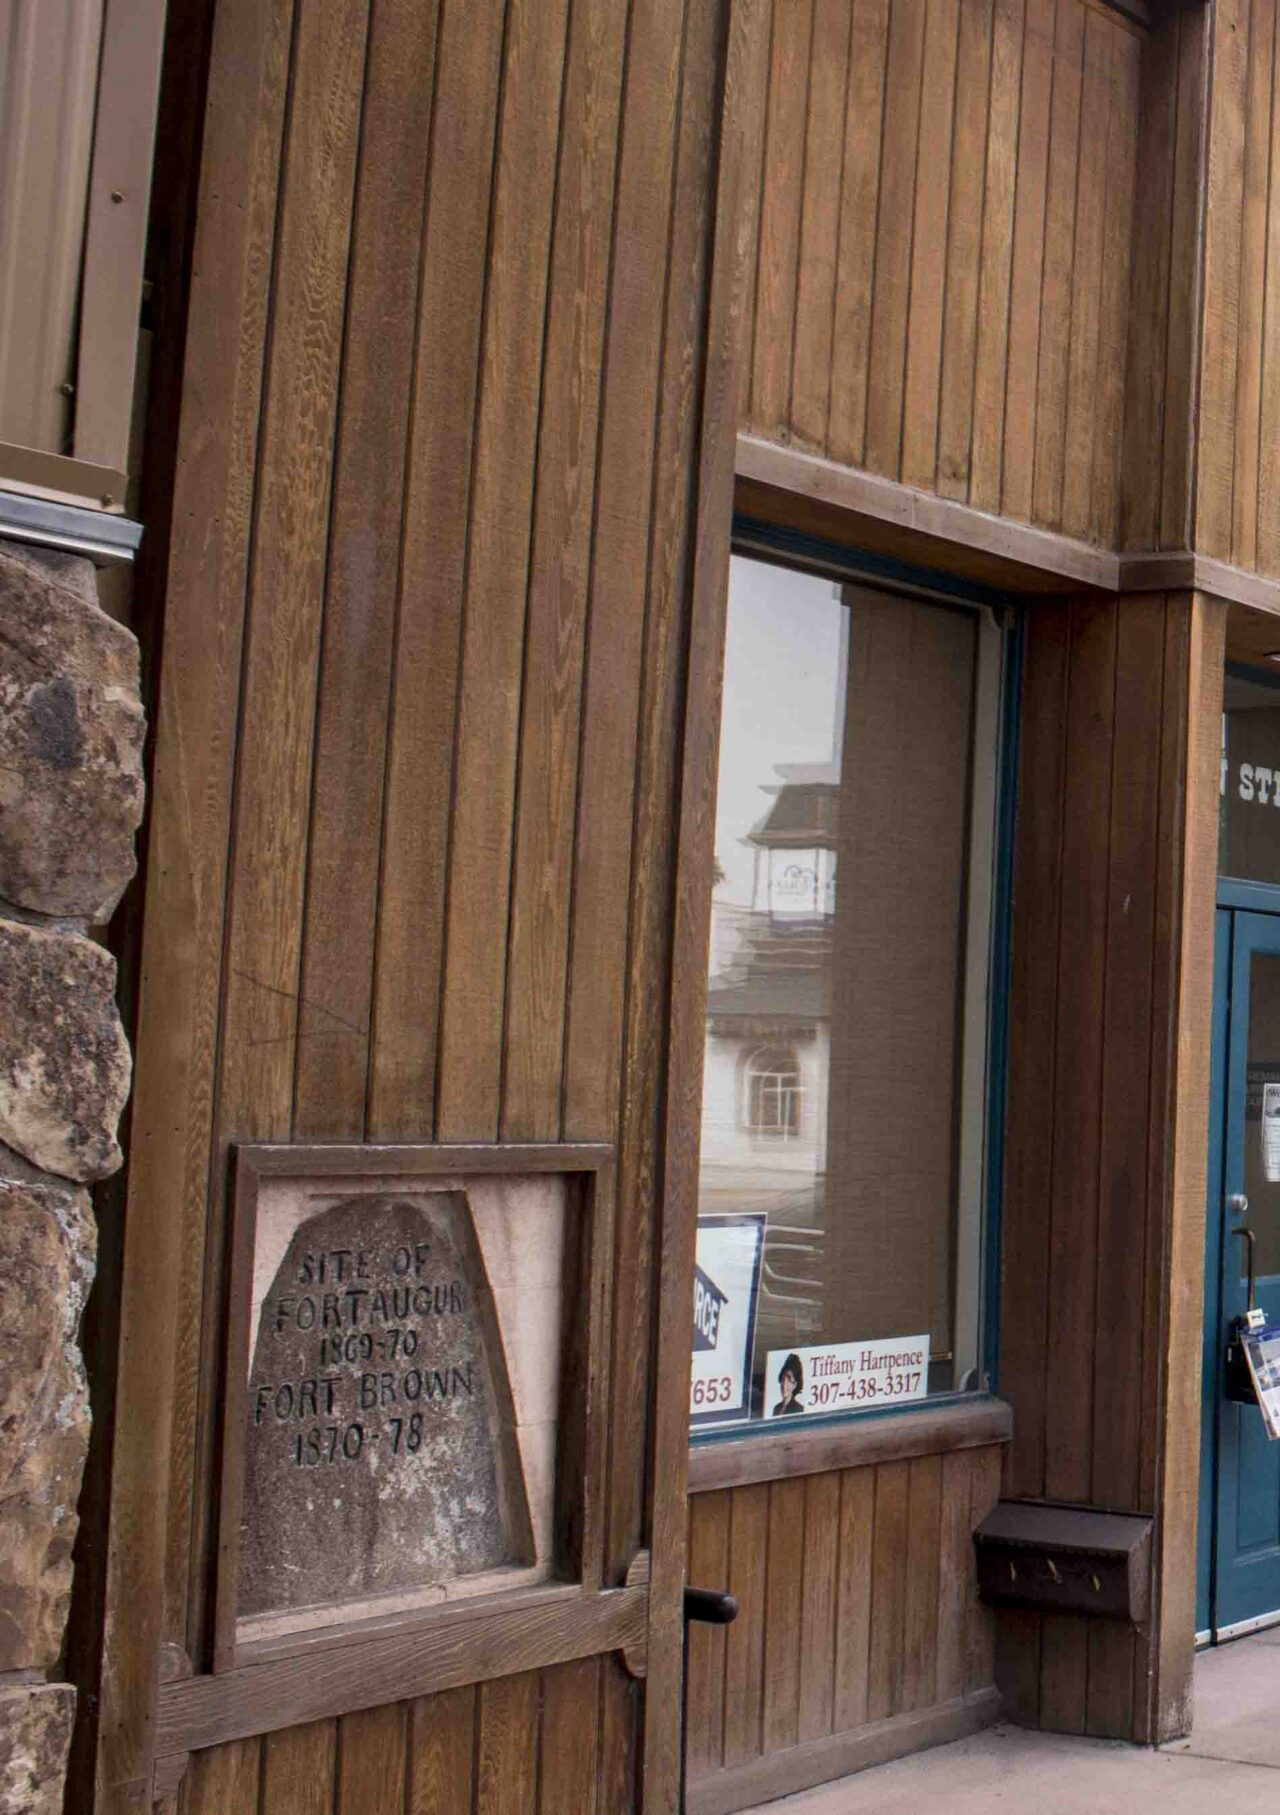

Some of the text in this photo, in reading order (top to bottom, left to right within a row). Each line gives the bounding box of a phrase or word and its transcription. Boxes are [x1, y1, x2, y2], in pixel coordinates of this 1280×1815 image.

[300, 1243, 431, 1285] SITE OF
[275, 1288, 369, 1333] FORT
[810, 1350, 923, 1379] Tiffany Hartpence
[255, 1364, 474, 1424] FORT BROWN
[808, 1371, 921, 1406] 307-438-3317
[295, 1412, 424, 1466] 1870-78
